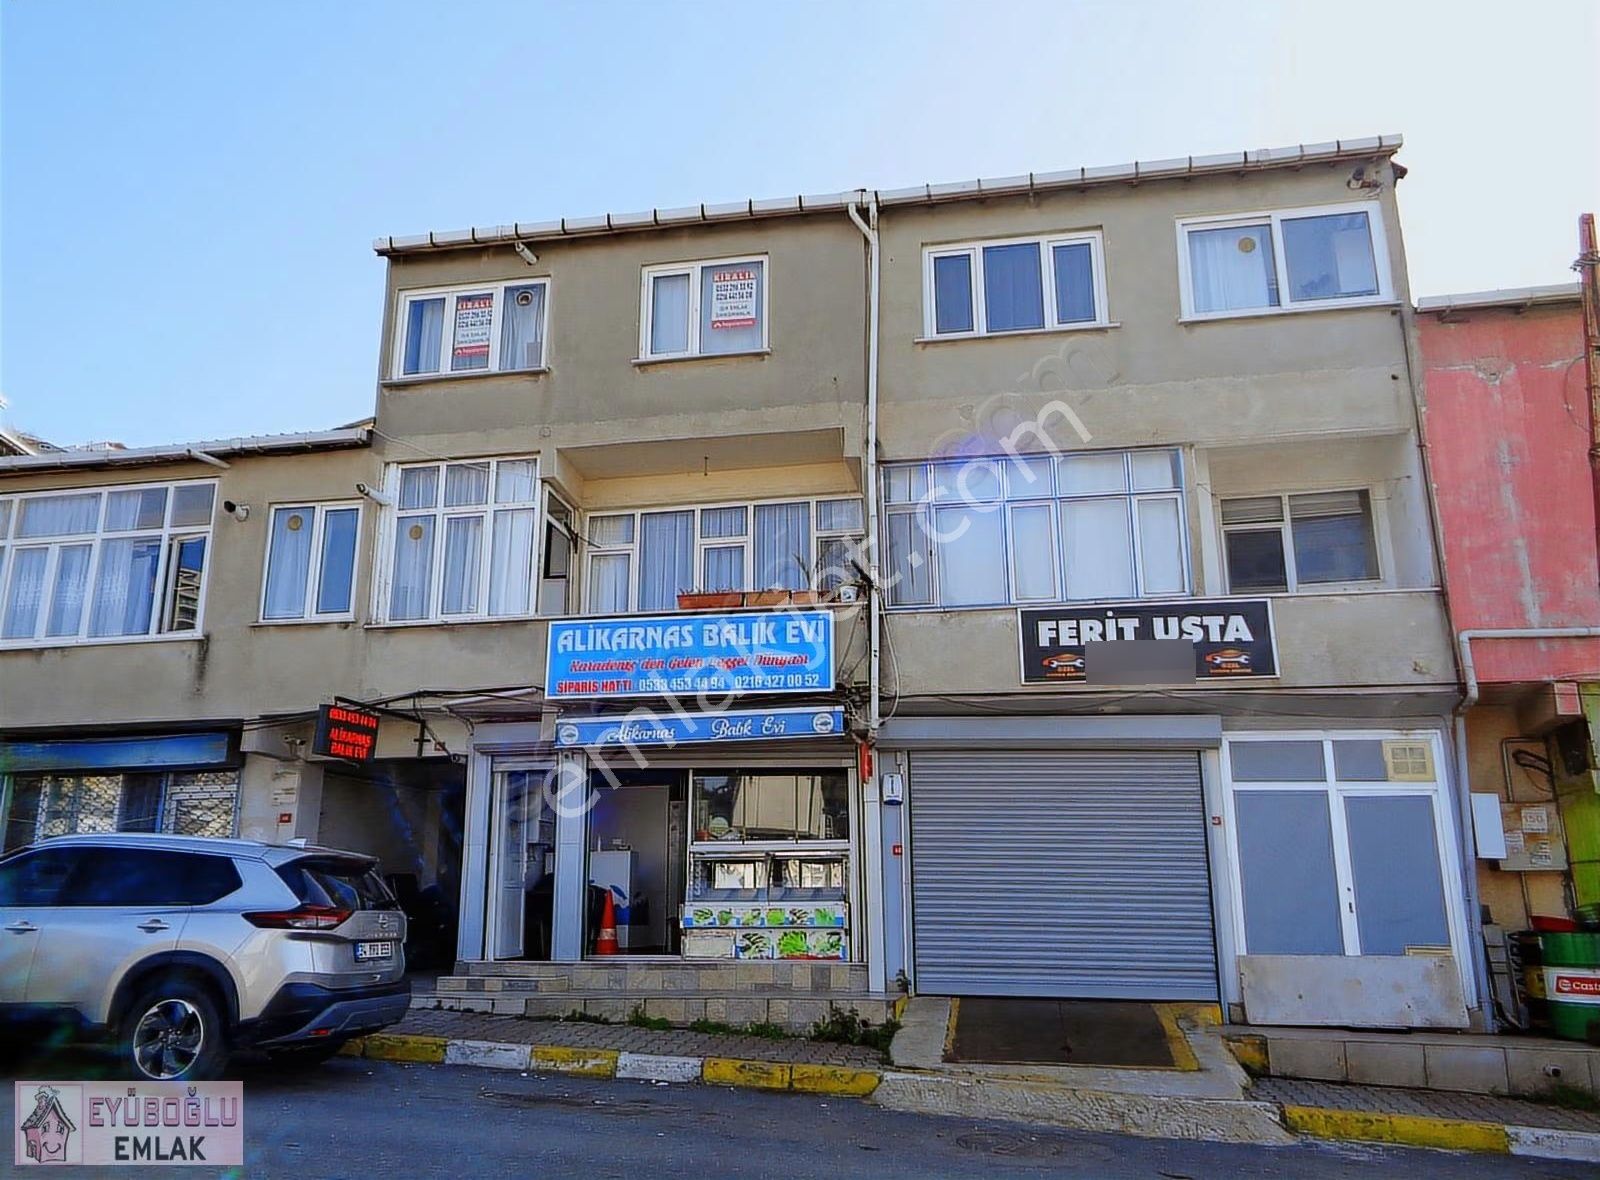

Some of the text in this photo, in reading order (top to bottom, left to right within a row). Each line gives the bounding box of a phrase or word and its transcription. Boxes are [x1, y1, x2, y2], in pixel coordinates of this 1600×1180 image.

[557, 614, 825, 654] ALİKARNAS BALIK EVİ
[1037, 610, 1255, 646] FERİT USTA
[711, 675, 725, 689] 94
[734, 675, 762, 689] 0216
[764, 674, 785, 689] 427
[786, 673, 802, 688] 00
[804, 672, 820, 687] 52
[760, 715, 786, 736] Evi
